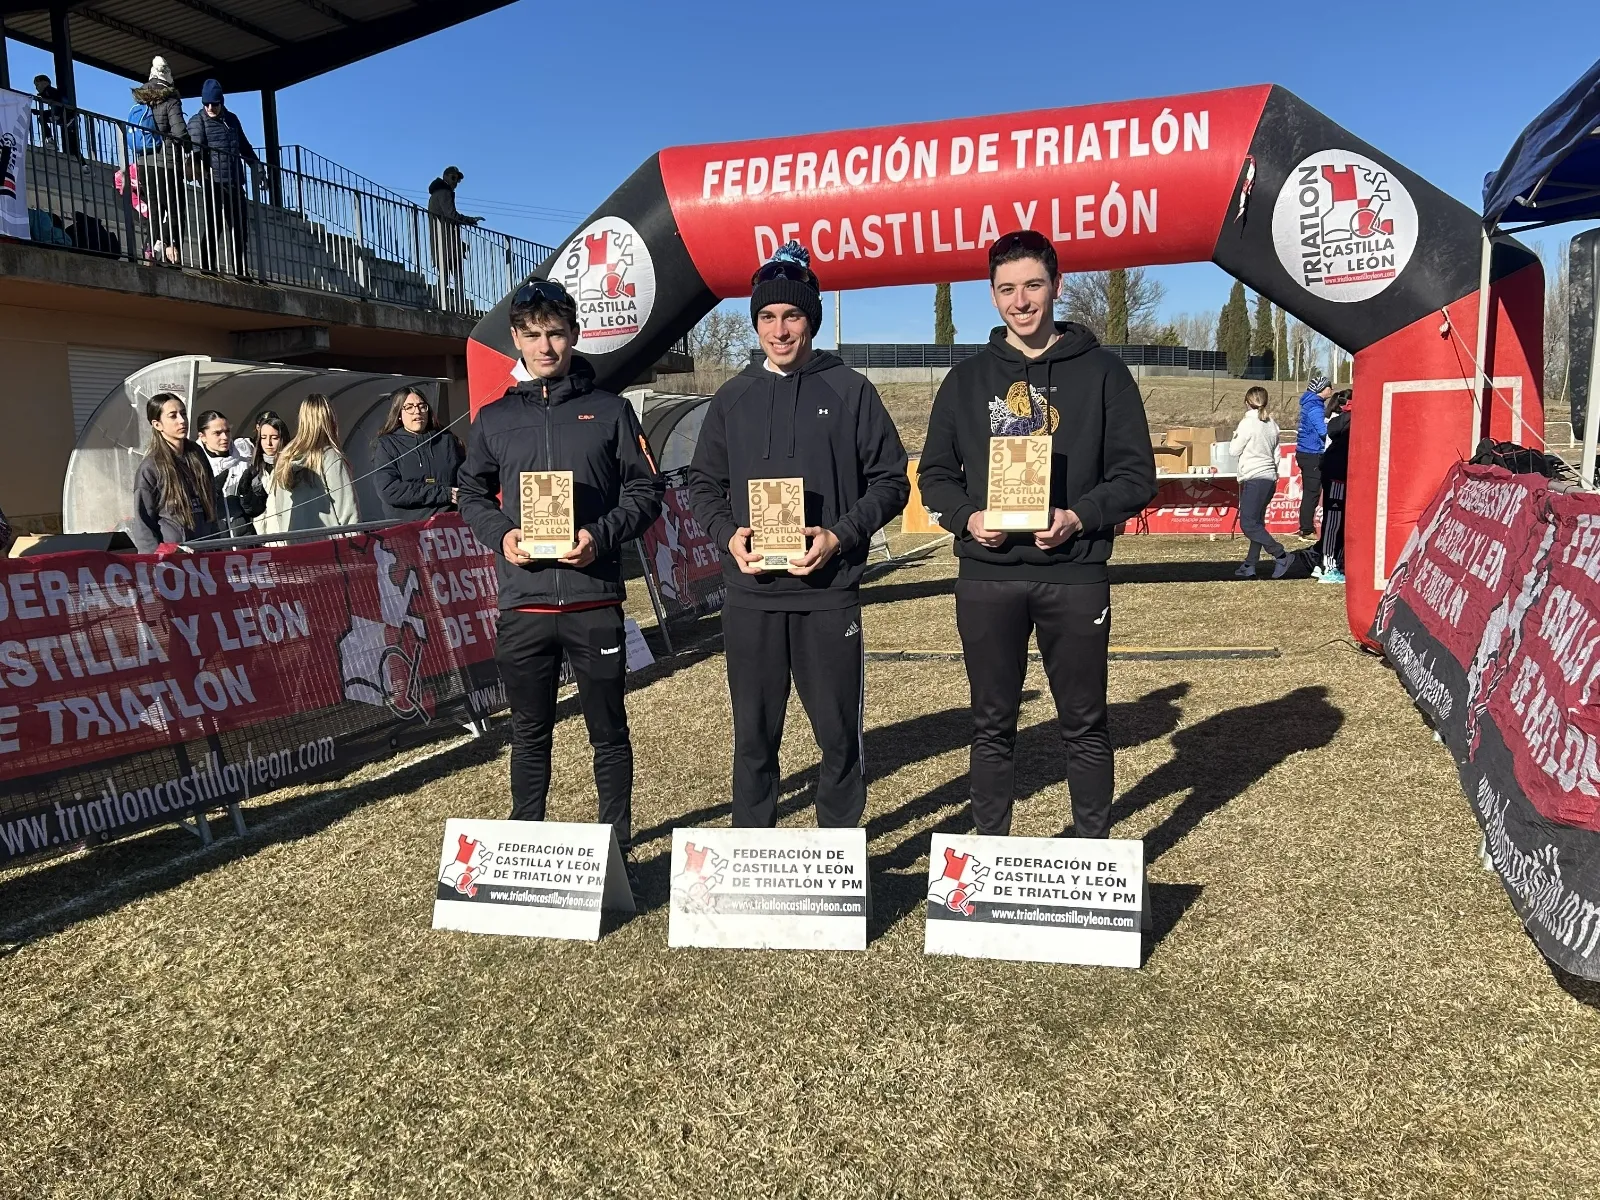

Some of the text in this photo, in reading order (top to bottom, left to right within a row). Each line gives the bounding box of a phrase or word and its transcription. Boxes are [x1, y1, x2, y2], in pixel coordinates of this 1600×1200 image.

[702, 107, 1210, 199] FEDERACIÓN DE TRIATLÓN
[811, 204, 1001, 263] CASTILLA
[1012, 199, 1039, 231] Y
[1052, 180, 1158, 242] LEÓN
[1298, 165, 1324, 287] TRIATLON
[1322, 238, 1395, 258] CASTILLA
[1323, 253, 1395, 274] Y LEÓN
[580, 300, 637, 314] CASTILLA
[581, 312, 638, 329] Y LEÓN
[989, 438, 1005, 512] TRIATLON
[1003, 487, 1045, 495] CASTILLA
[1003, 496, 1010, 504] Y
[523, 475, 533, 540] TRIATLON
[751, 482, 763, 549] TRIATLON
[224, 552, 276, 592] DE
[0, 592, 311, 689] STILLA Y LEÓN
[443, 613, 478, 649] DE
[35, 658, 257, 745] TRIATLÓN
[498, 842, 594, 857] FEDERACIÓN DE
[733, 846, 845, 860] FEDERACIÓN DE
[496, 856, 601, 872] CASTILLA Y LEÓN
[732, 861, 855, 874] CASTILLA Y LEÓN
[995, 856, 1118, 872] FEDERACIÓN DE
[493, 869, 509, 879] DE
[513, 870, 572, 883] TRIATLÓN
[576, 875, 584, 884] Y
[732, 875, 863, 889] DE TRIATLÓN Y PM
[994, 871, 1128, 888] CASTILLA Y LEÓN
[490, 889, 601, 908] www.triatloncastillayleon.com
[993, 885, 1136, 904] DE TRIATLÓN Y PM
[991, 908, 1134, 928] www.triatloncastillayleon.com
